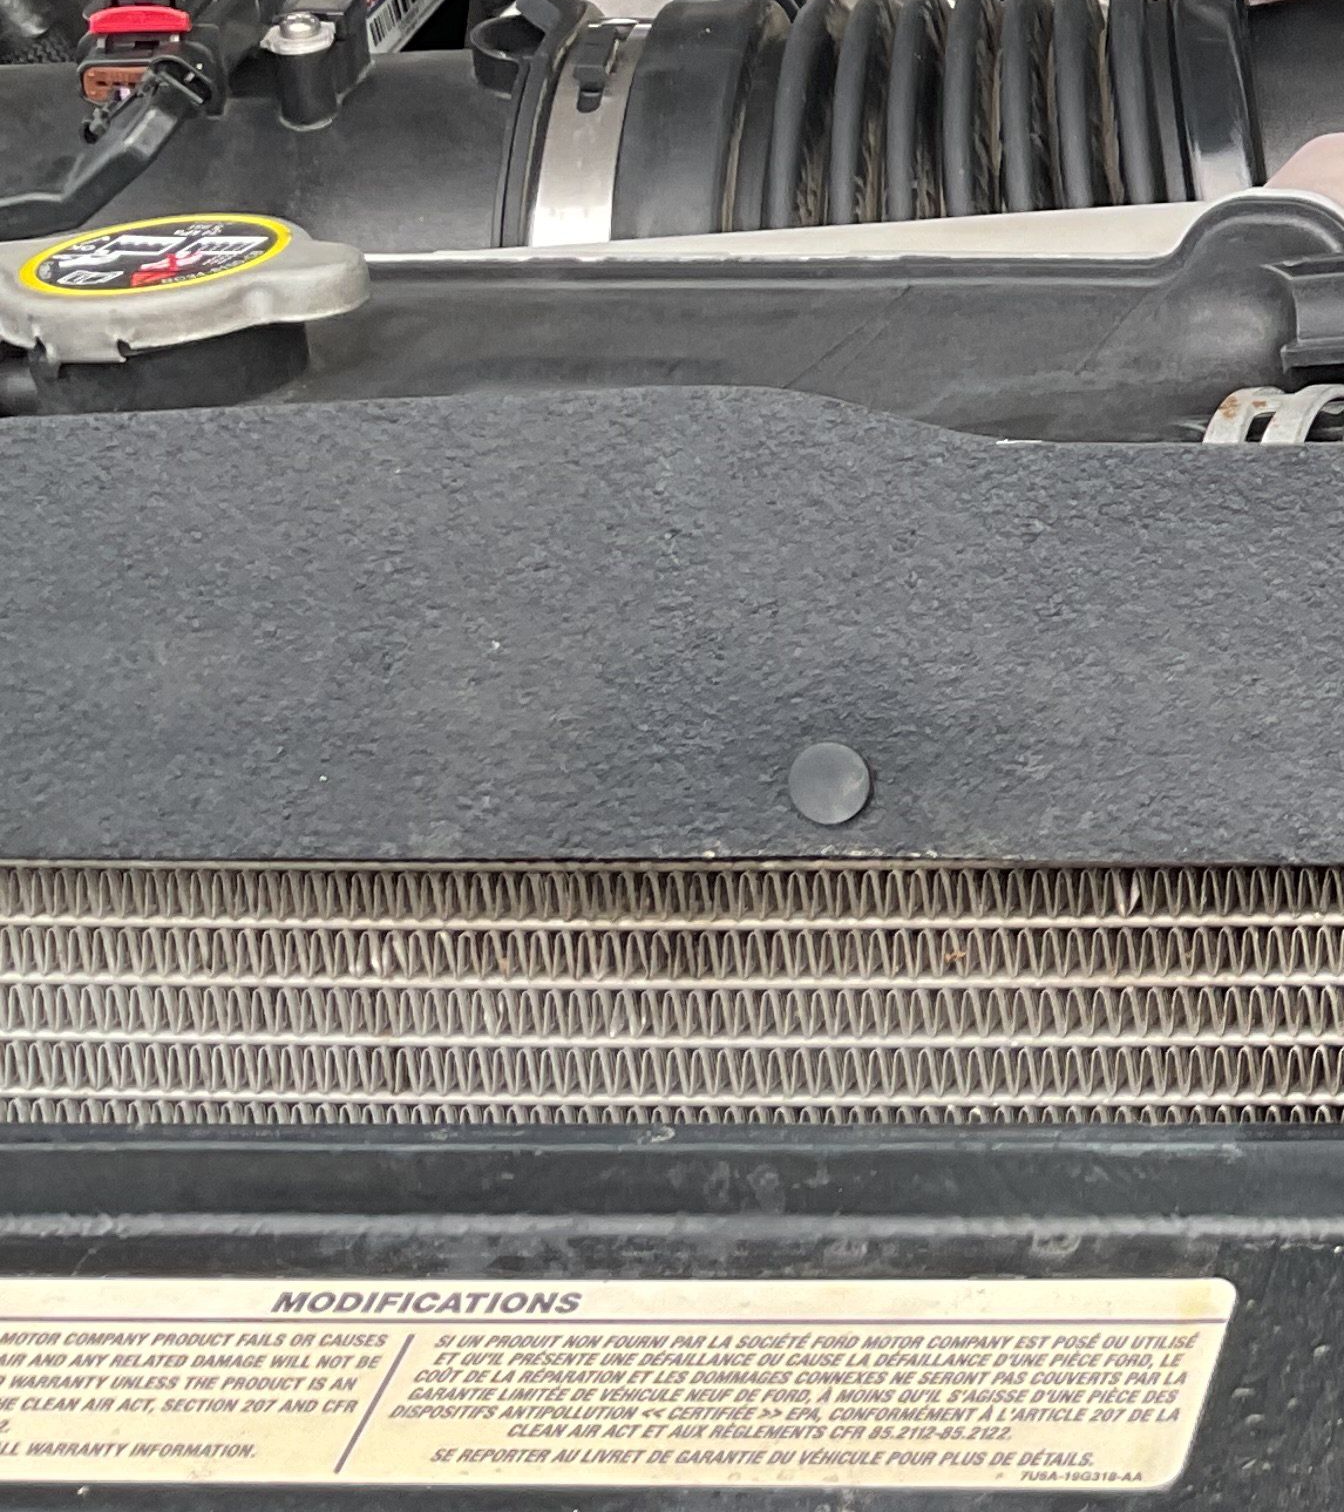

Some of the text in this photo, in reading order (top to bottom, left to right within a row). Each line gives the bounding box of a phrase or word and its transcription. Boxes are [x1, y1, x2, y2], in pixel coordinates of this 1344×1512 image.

[270, 1291, 583, 1314] MODIFICATIONS
[1, 1332, 389, 1347] MOTOR COMPANY PRODUCT FAILS OR CAUSES
[434, 1332, 1199, 1349] SI UN PRODUIT NON FOURNI PAR LA SOCIÉTÉ FORD MOTOR COMPANY EST POSÉ OU UTILISÉ
[27, 1353, 67, 1368] AND
[68, 1353, 109, 1368] ANY
[109, 1354, 189, 1368] RELATED
[190, 1354, 267, 1368] DAMAGE
[269, 1354, 315, 1369] WILL
[315, 1354, 353, 1369] NOT
[355, 1354, 383, 1369] BE
[432, 1352, 460, 1366] ET
[507, 1350, 600, 1366] PRÉSENTE
[600, 1352, 639, 1366] UNE
[637, 1350, 757, 1367] DÉFAILLANCE
[757, 1352, 785, 1367] OU
[785, 1352, 845, 1367] CAUSE
[845, 1352, 871, 1367] LA
[873, 1350, 990, 1367] DÉFAILLANCE
[1049, 1350, 1103, 1367] PIÈCE
[1103, 1353, 1153, 1369] FORD,
[1159, 1353, 1184, 1367] LE
[9, 1375, 109, 1389] WARRANTY
[110, 1376, 181, 1390] UNLESS
[184, 1376, 219, 1390] THE
[220, 1376, 307, 1390] PRODUCT
[308, 1376, 327, 1390] IS
[329, 1376, 358, 1390] AN
[413, 1366, 1188, 1385] COÛT DE LA RÉPARATION ET LES DOMMAGES CONNEXES NE SERONT PAS COUVERTS PAR LA
[407, 1388, 498, 1401] GARANTIE
[497, 1385, 569, 1402] LIMITÉE
[570, 1388, 598, 1402] DE
[599, 1385, 685, 1402] VÉHICULE
[684, 1389, 733, 1402] NEUF
[733, 1389, 761, 1403] DE
[761, 1389, 812, 1404] FORD,
[835, 1389, 895, 1403] MOINS
[946, 1389, 1030, 1403] S'AGISSE
[1086, 1387, 1142, 1404] PIÈCE
[1141, 1389, 1179, 1404] DES
[20, 1397, 81, 1412] CLEAN
[81, 1397, 115, 1412] AIR
[116, 1398, 157, 1413] ACT,
[161, 1398, 238, 1413] SECTION
[240, 1398, 277, 1413] 207
[277, 1399, 319, 1413] AND
[321, 1399, 358, 1413] CFR
[387, 1405, 499, 1419] DISPOSITIFS
[498, 1406, 639, 1420] ANTIPOLLUTION
[667, 1403, 758, 1420] CERTIFIÉE
[785, 1407, 822, 1422] EPA,
[828, 1405, 979, 1421] CONFORMÉMENT
[995, 1407, 1089, 1422] L'ARTICLE
[1089, 1407, 1127, 1422] 207
[1127, 1407, 1156, 1422] DE
[1155, 1407, 1181, 1422] LA
[507, 1424, 568, 1438] CLEAN
[567, 1424, 602, 1438] AIR
[601, 1424, 642, 1438] ACT
[641, 1424, 668, 1438] ET
[667, 1424, 709, 1438] AUX
[829, 1425, 867, 1439] CFR
[25, 1442, 129, 1457] WARRANTY
[128, 1443, 257, 1458] INFORMATION.
[430, 1447, 1095, 1466] SE REPORTER AU LIVRET DE GARANTIE DU VÉHICULE POUR PLUS DE DÉTAILS.
